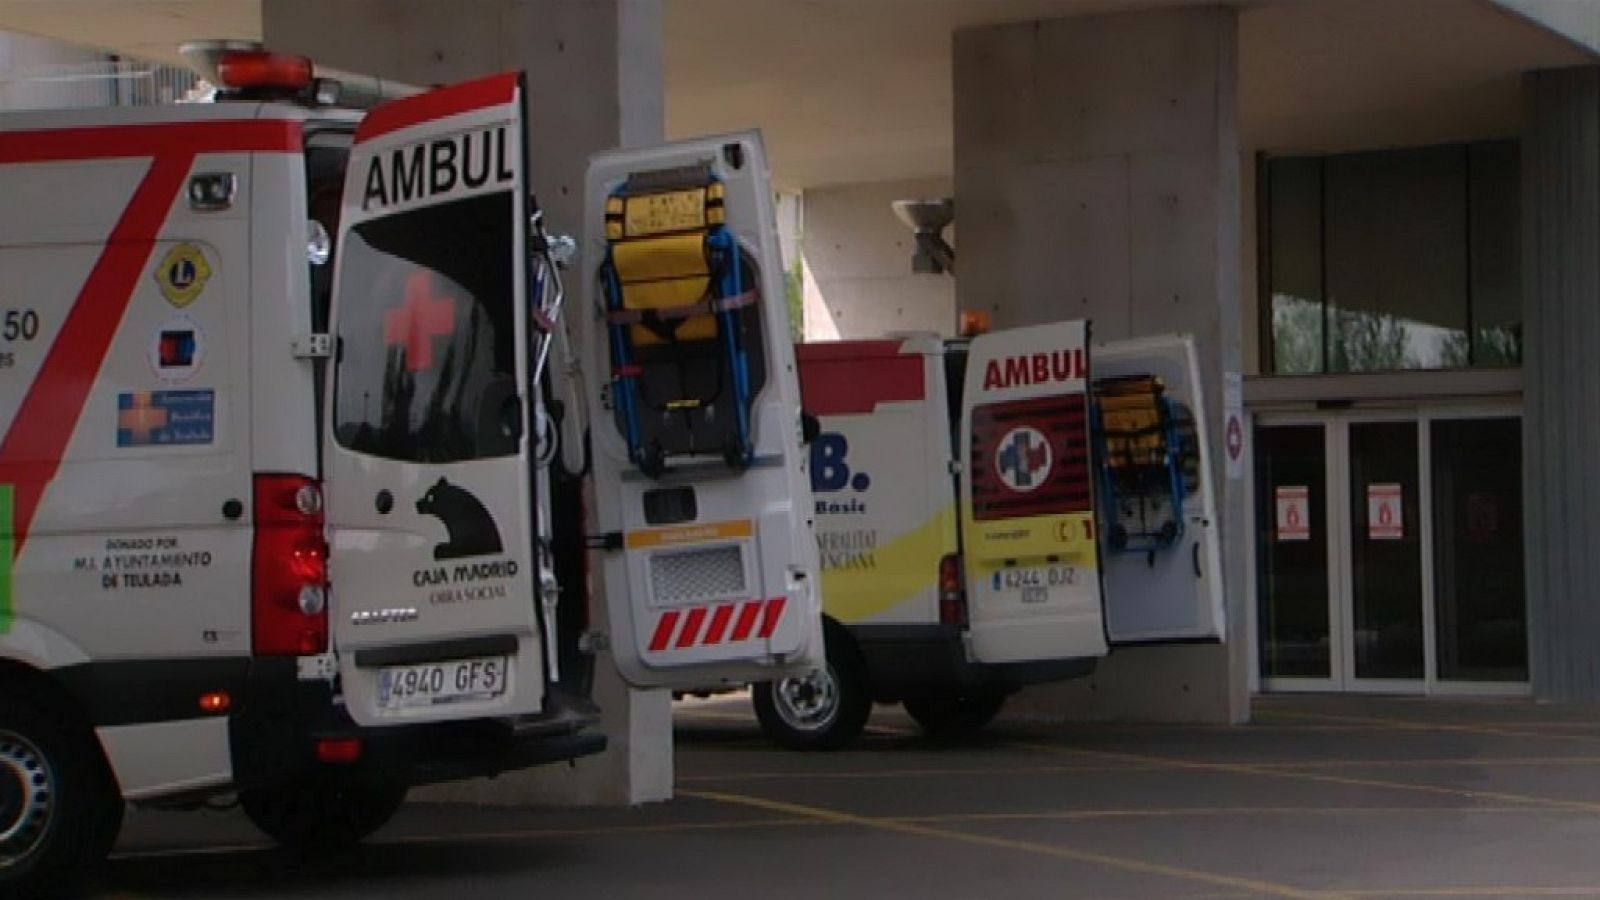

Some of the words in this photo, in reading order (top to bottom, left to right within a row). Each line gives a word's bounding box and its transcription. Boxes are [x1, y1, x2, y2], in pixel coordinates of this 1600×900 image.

[362, 127, 513, 211] AMBUL
[3, 309, 40, 342] 50
[983, 349, 1086, 391] AMBUL
[103, 551, 212, 569] AYUNTAMIENTO
[413, 569, 448, 587] CAJA
[453, 560, 519, 582] MADRID
[123, 572, 183, 588] TEULADA
[392, 667, 444, 697] 4940
[456, 661, 496, 690] GFS
